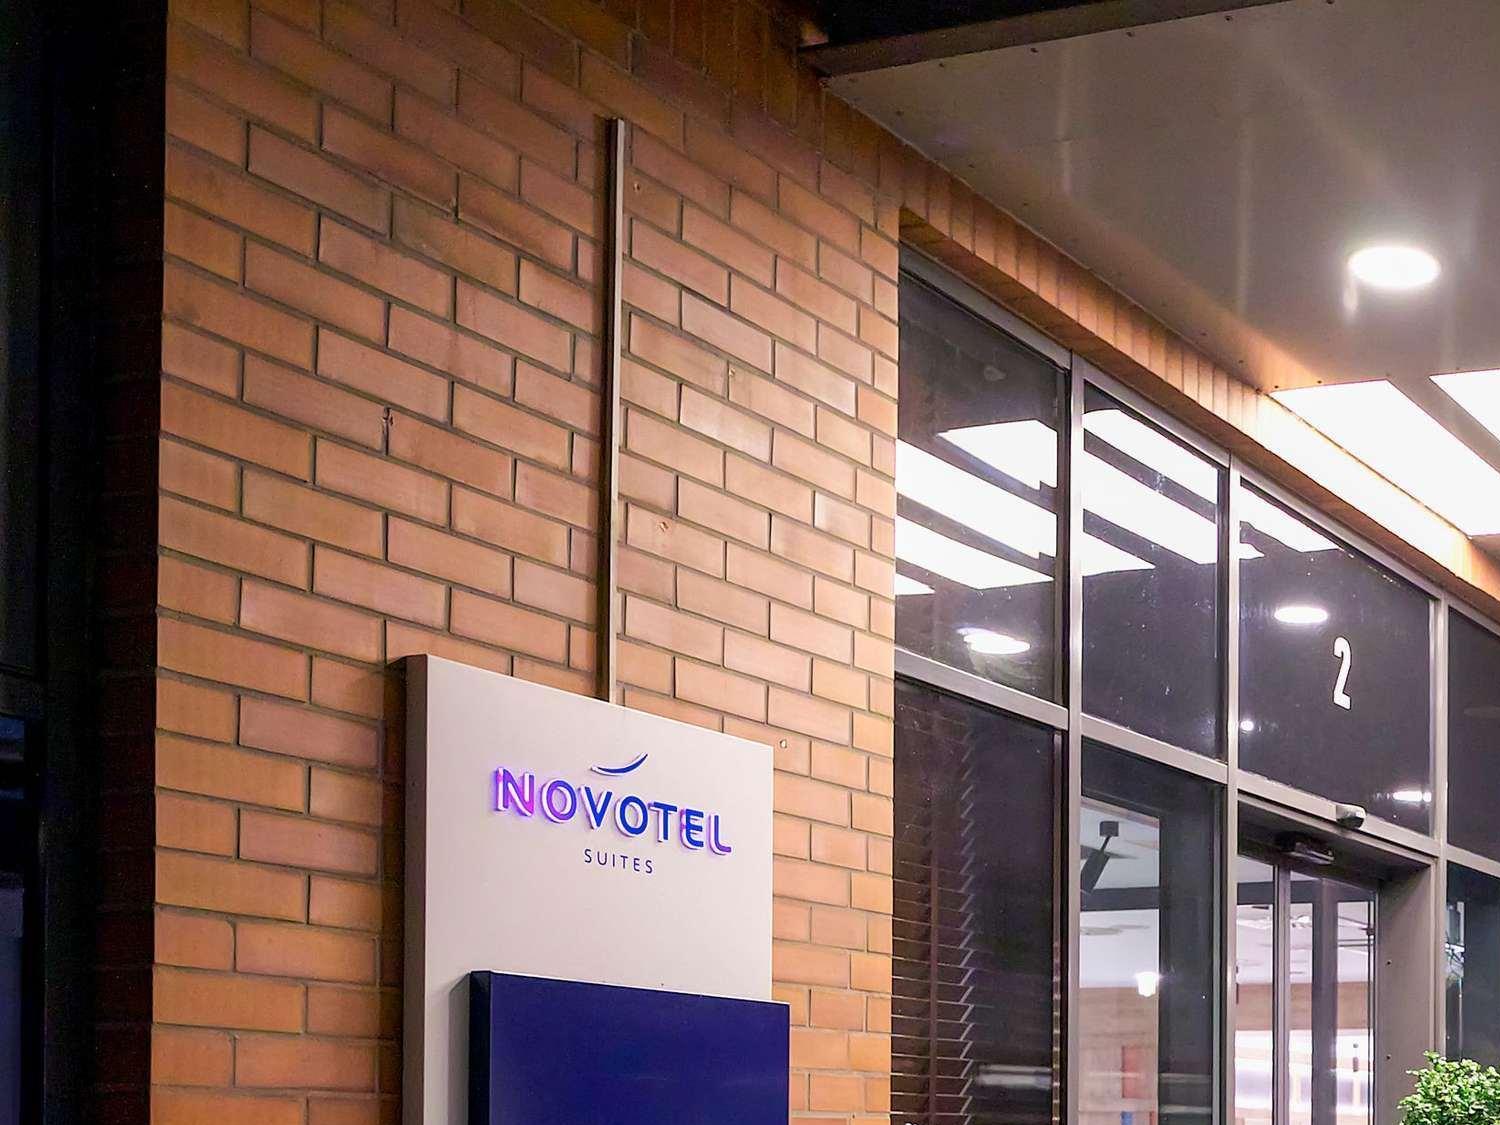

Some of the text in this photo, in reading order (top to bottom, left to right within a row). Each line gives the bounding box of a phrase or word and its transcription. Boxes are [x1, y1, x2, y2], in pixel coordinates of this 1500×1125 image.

[1333, 637, 1351, 710] 2
[494, 767, 732, 856] NOVOTEL
[584, 848, 655, 875] SUITES
